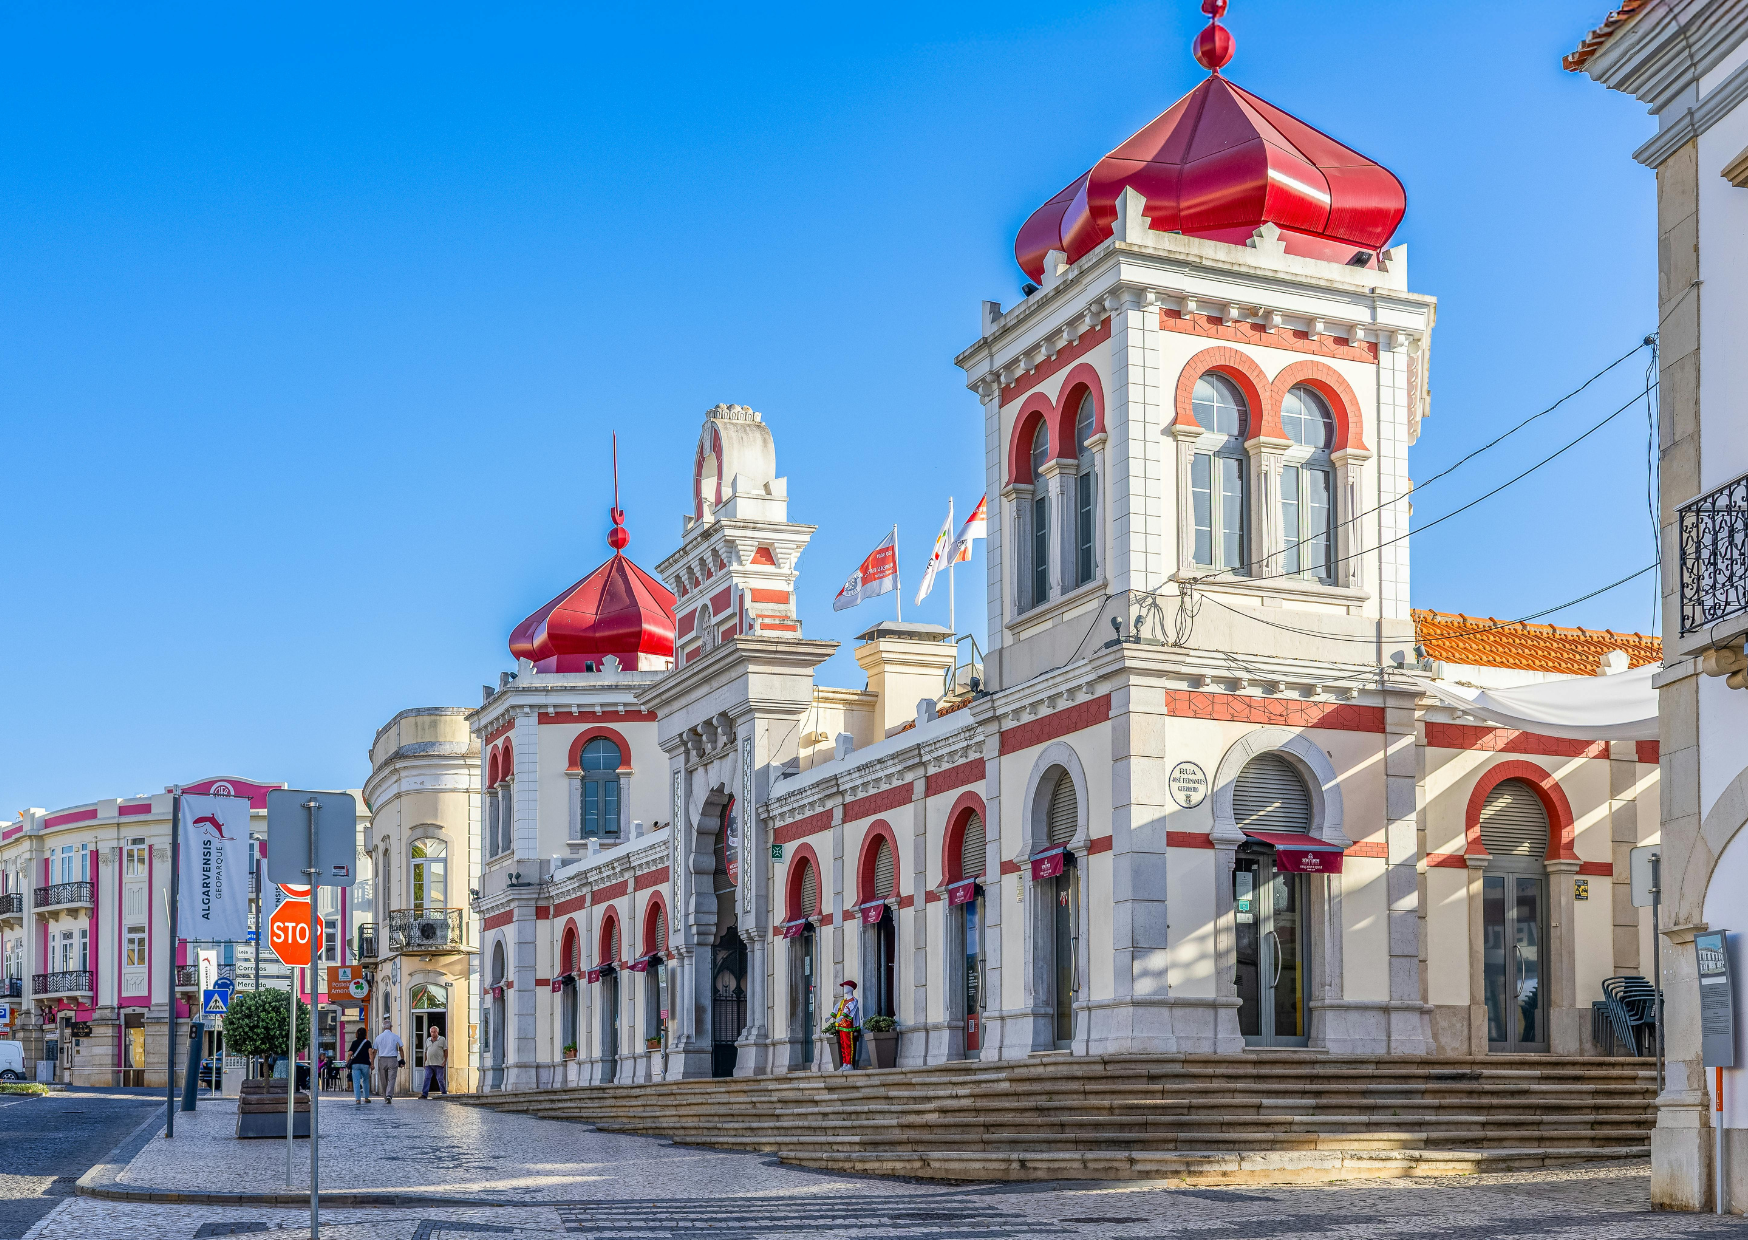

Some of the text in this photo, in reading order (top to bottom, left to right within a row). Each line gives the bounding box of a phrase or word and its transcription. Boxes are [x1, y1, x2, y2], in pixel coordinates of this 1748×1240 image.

[1179, 768, 1196, 776] RUA
[202, 840, 212, 920] ALGARVENSIS
[215, 846, 223, 900] GEOPARQUE
[237, 964, 267, 972] Corros
